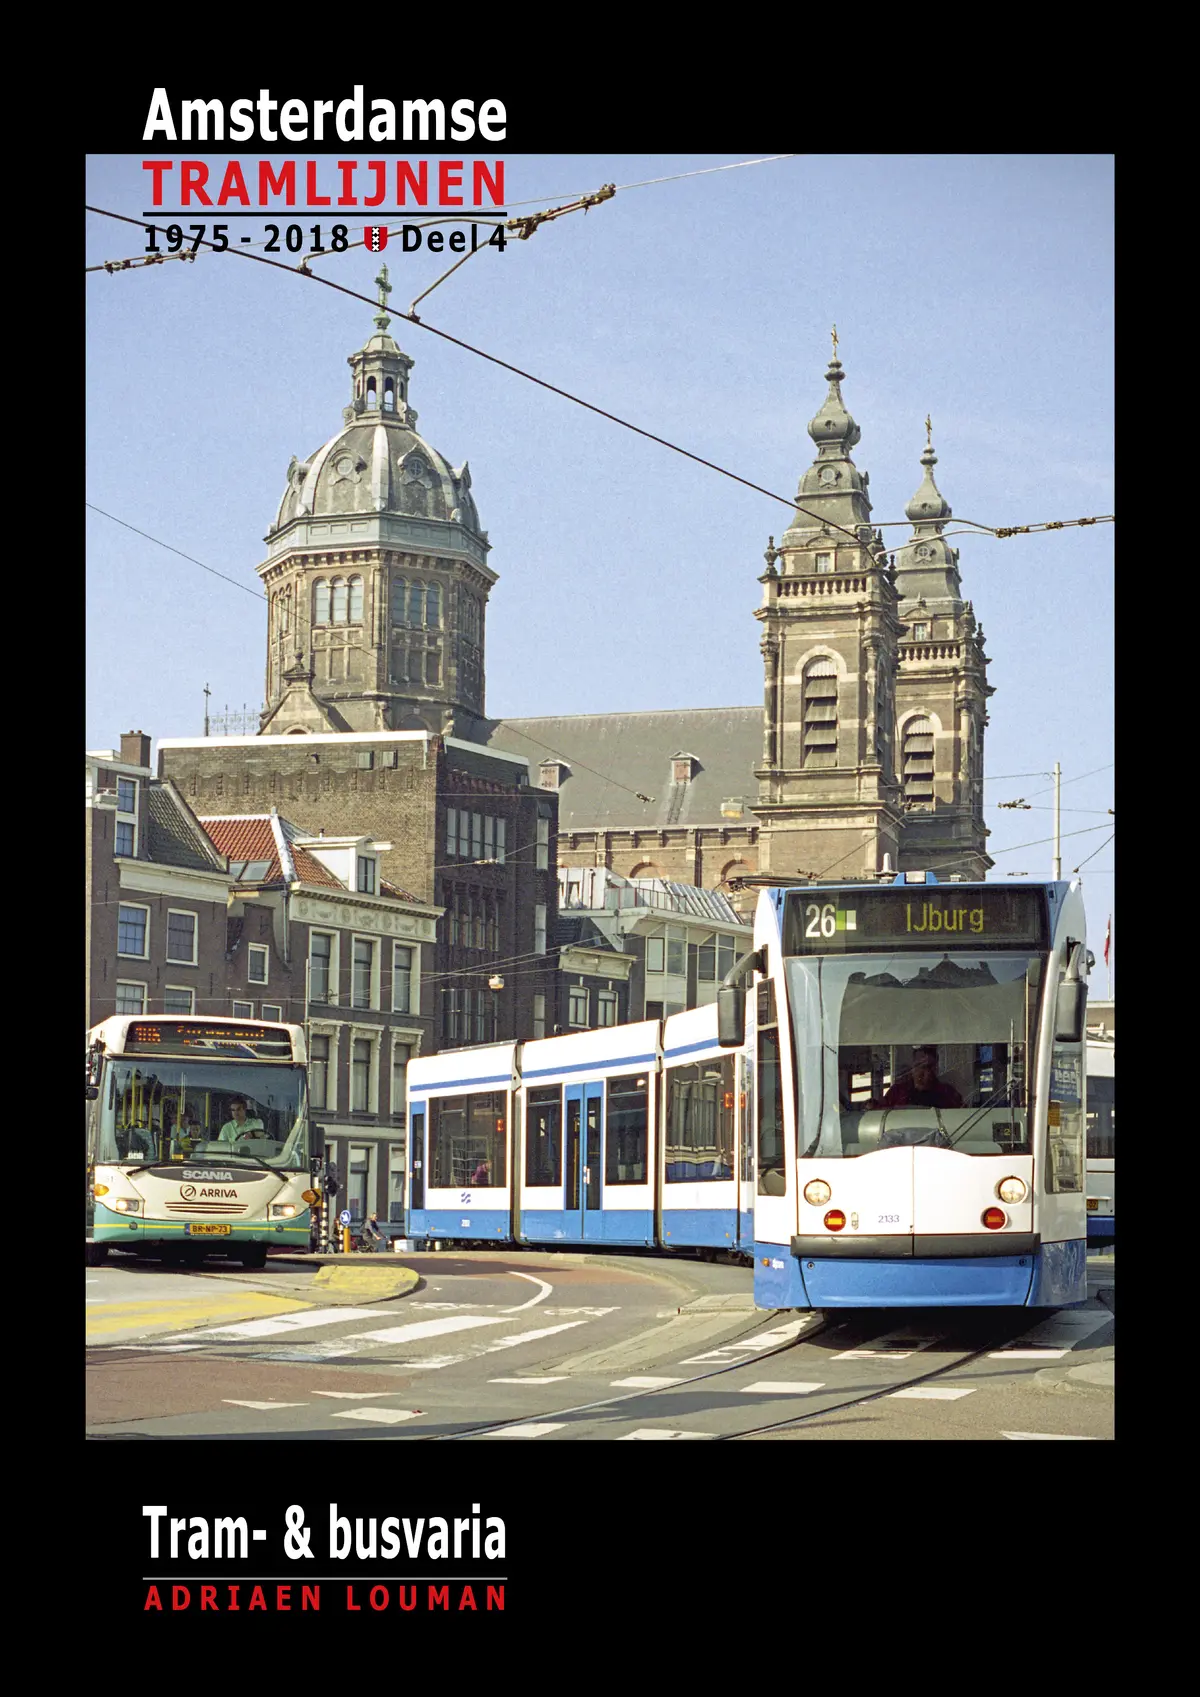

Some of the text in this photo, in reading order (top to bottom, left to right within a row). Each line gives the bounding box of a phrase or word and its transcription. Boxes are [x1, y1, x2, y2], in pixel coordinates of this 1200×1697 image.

[805, 903, 984, 938] 26 IJburg
[182, 1170, 234, 1181] SCANIA
[199, 1189, 238, 1199] ARRIVA
[878, 1215, 900, 1223] 2133
[192, 1225, 228, 1233] BR-NP-73
